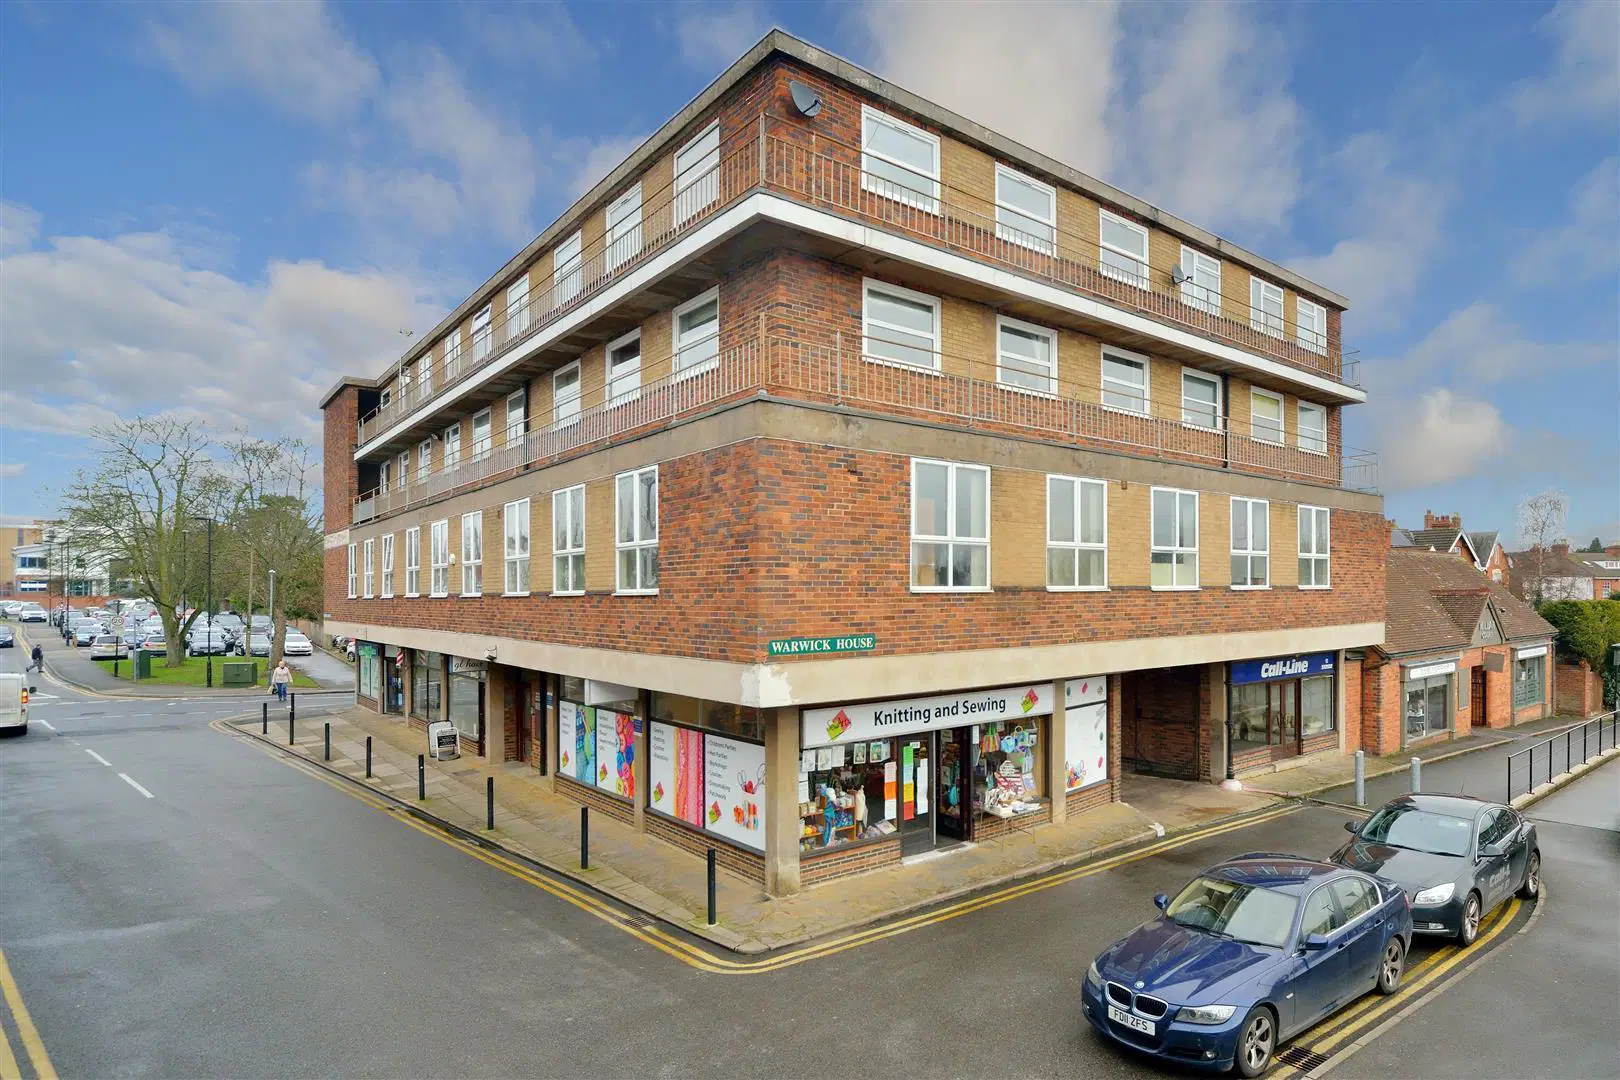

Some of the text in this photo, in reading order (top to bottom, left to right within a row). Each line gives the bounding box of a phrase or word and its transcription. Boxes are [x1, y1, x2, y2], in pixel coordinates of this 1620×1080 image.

[771, 637, 873, 653] WARWICK HOUSE
[1260, 659, 1309, 678] Call-Line
[874, 706, 931, 727] Knitting
[934, 700, 959, 719] and
[962, 697, 1007, 715] Sewing
[1130, 1016, 1148, 1031] ZFS
